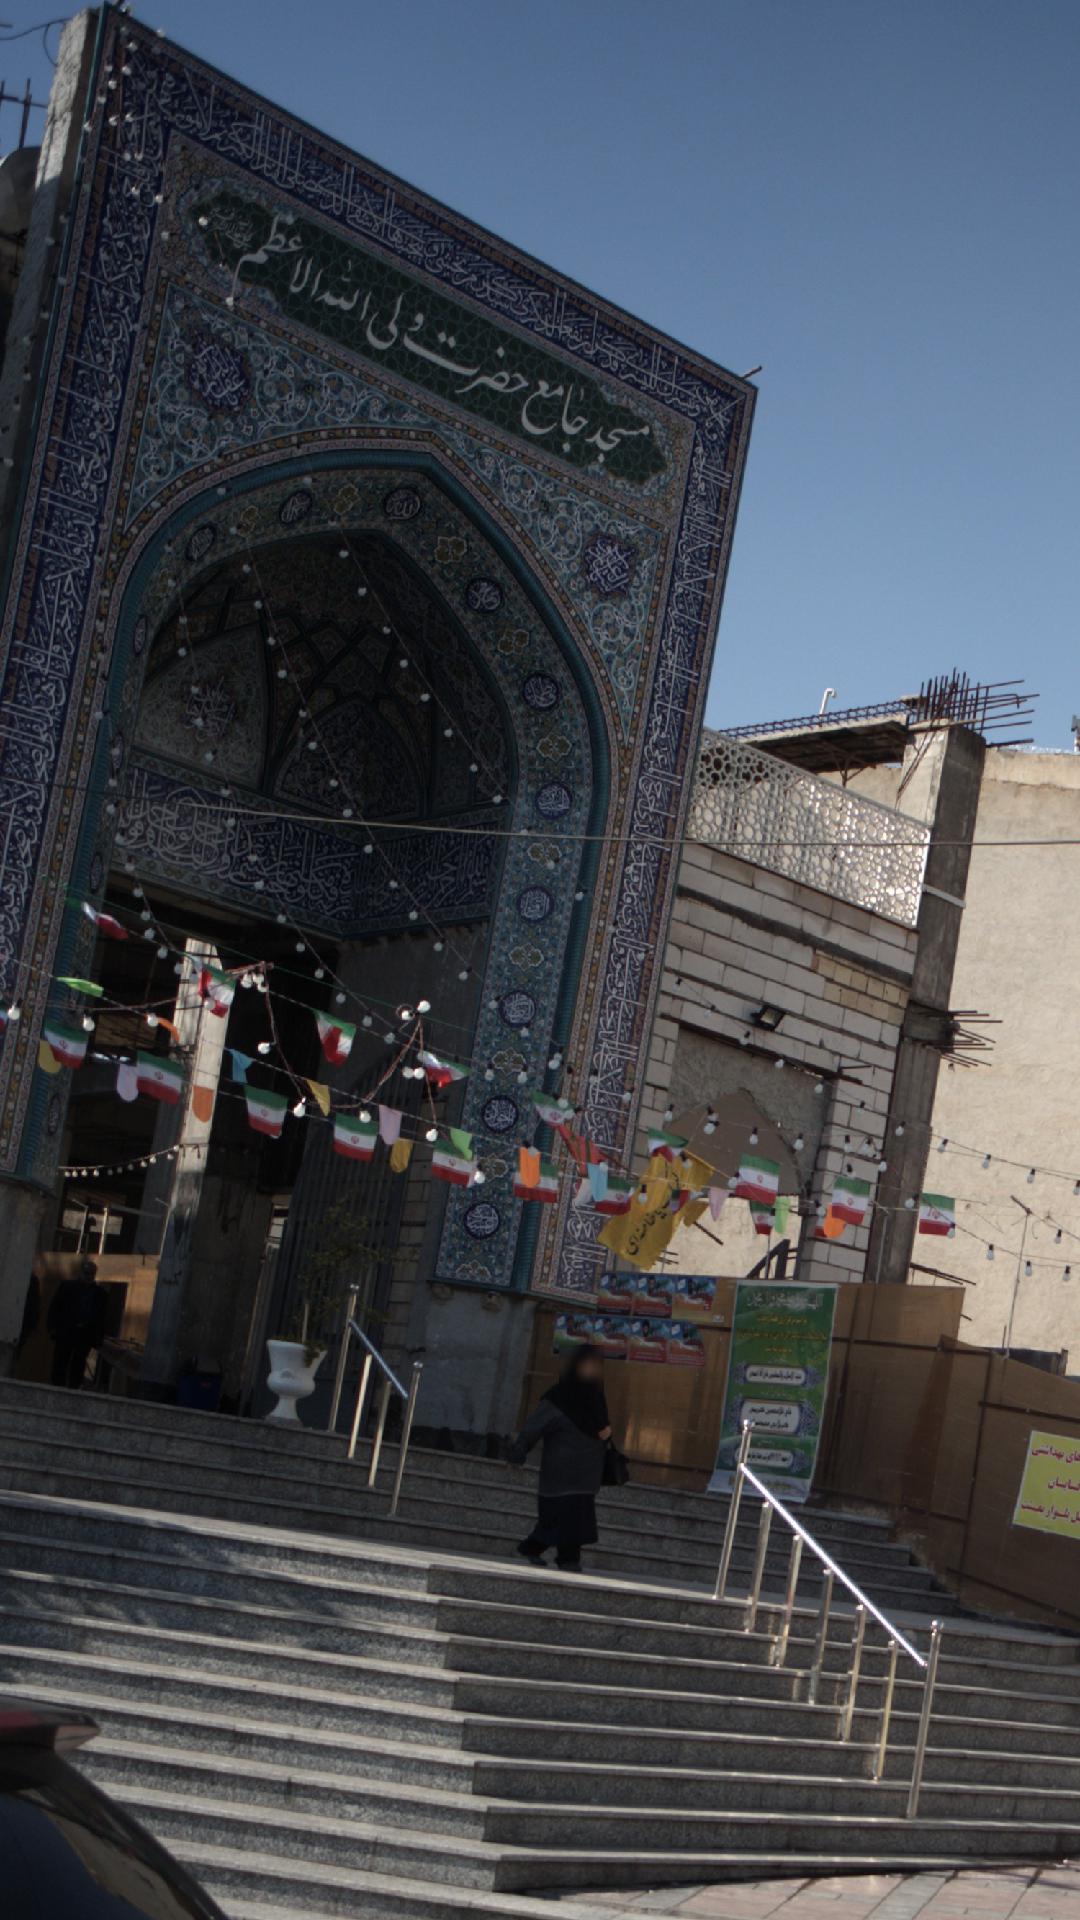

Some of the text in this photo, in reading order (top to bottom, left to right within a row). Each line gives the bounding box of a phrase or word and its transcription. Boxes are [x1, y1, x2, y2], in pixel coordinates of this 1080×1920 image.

[314, 260, 372, 322] الله
[365, 292, 424, 350] ولی
[403, 331, 529, 394] حضرت
[521, 379, 589, 454] جامع
[585, 425, 650, 463] مسجد
